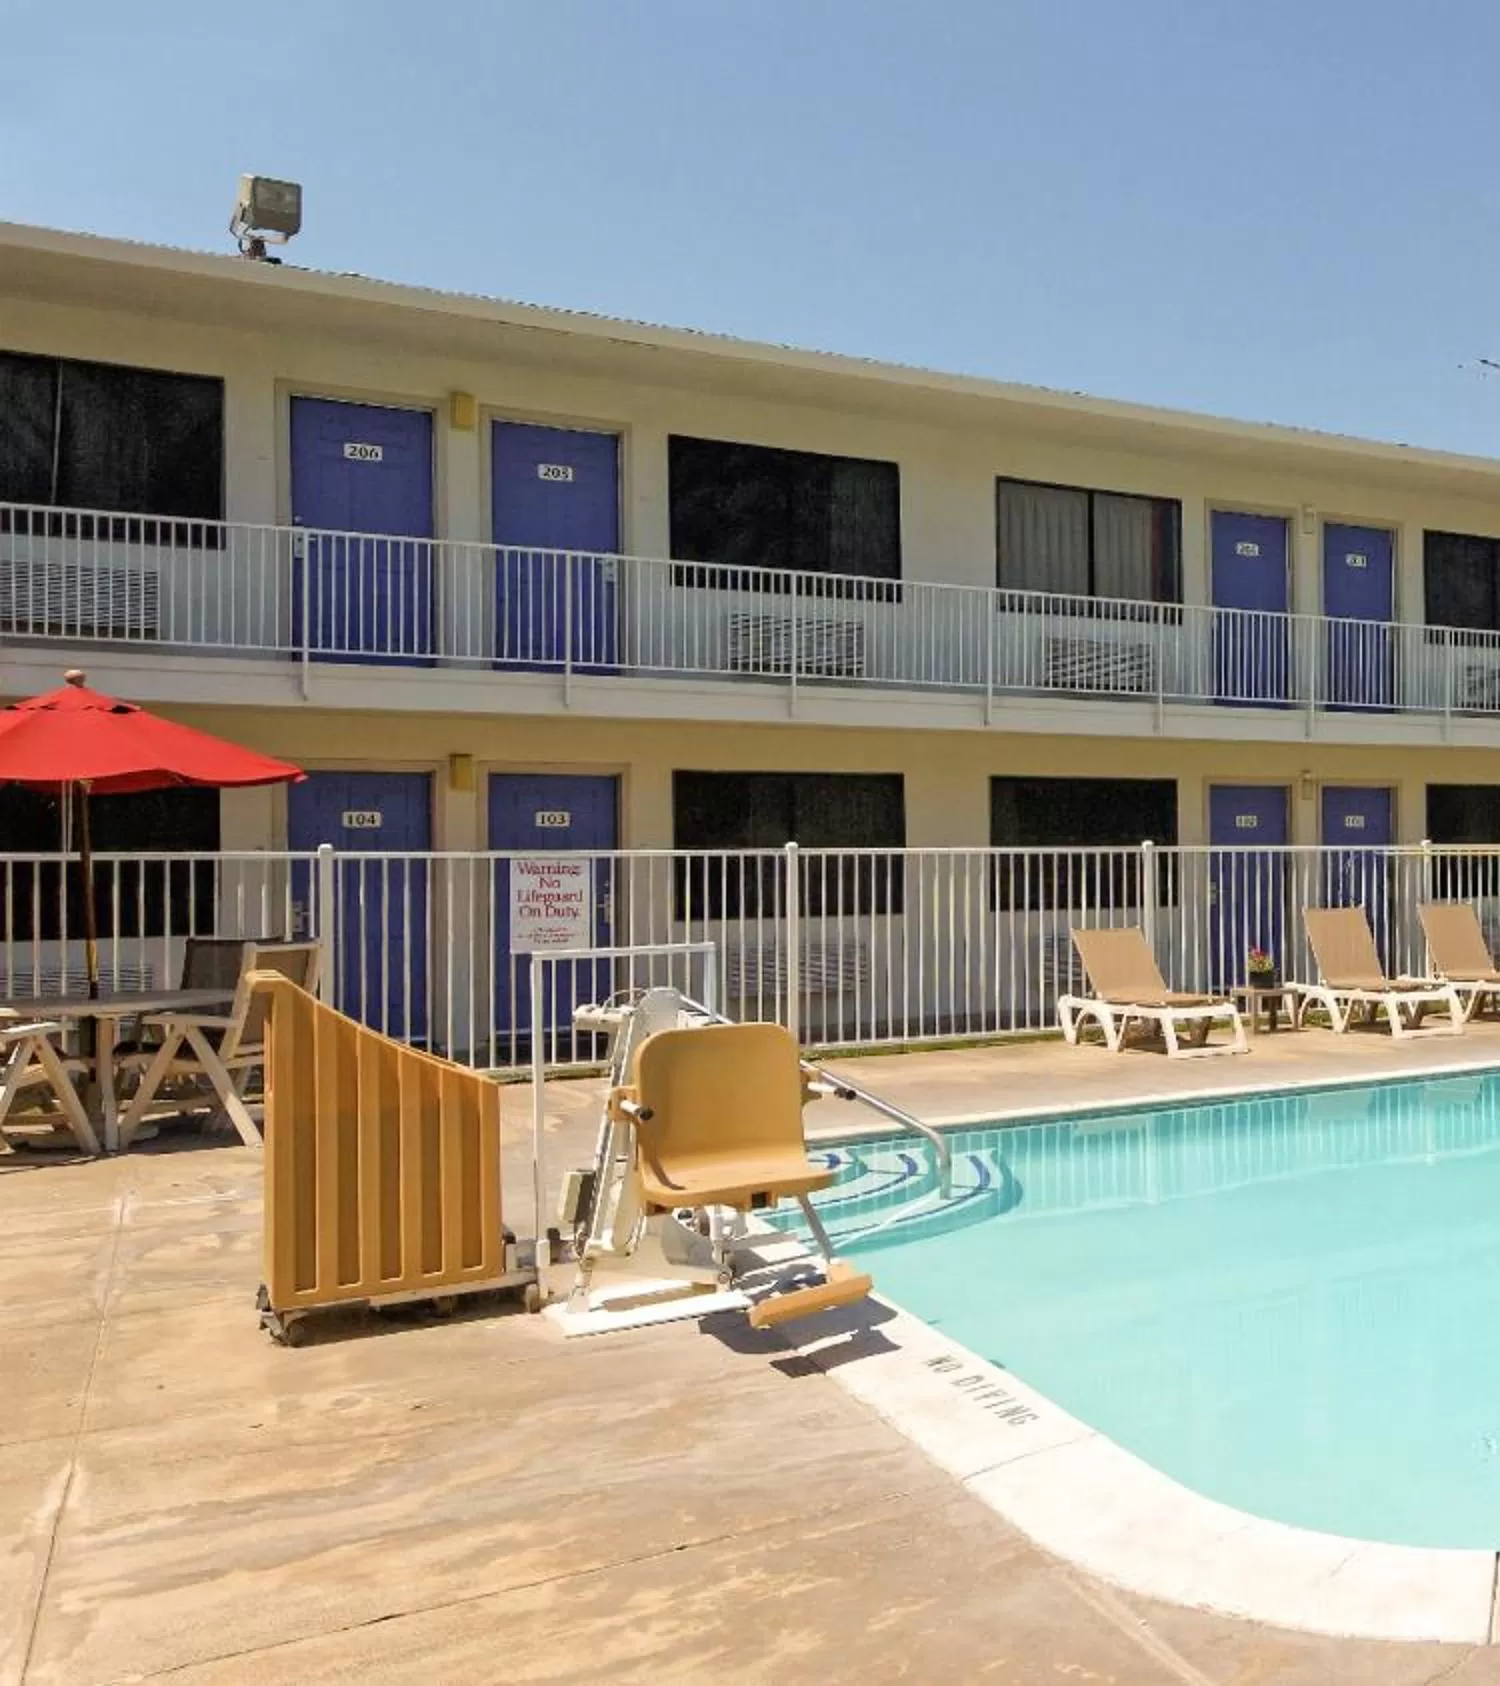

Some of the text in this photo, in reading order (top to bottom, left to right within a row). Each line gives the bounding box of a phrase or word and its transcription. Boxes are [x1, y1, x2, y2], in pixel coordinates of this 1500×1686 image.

[348, 445, 379, 459] 206
[346, 813, 377, 825] 104
[540, 813, 566, 825] 103
[540, 877, 561, 888] No
[517, 889, 583, 907] Lifeguard
[519, 905, 541, 917] On
[924, 1354, 1040, 1427] NO DIVING
